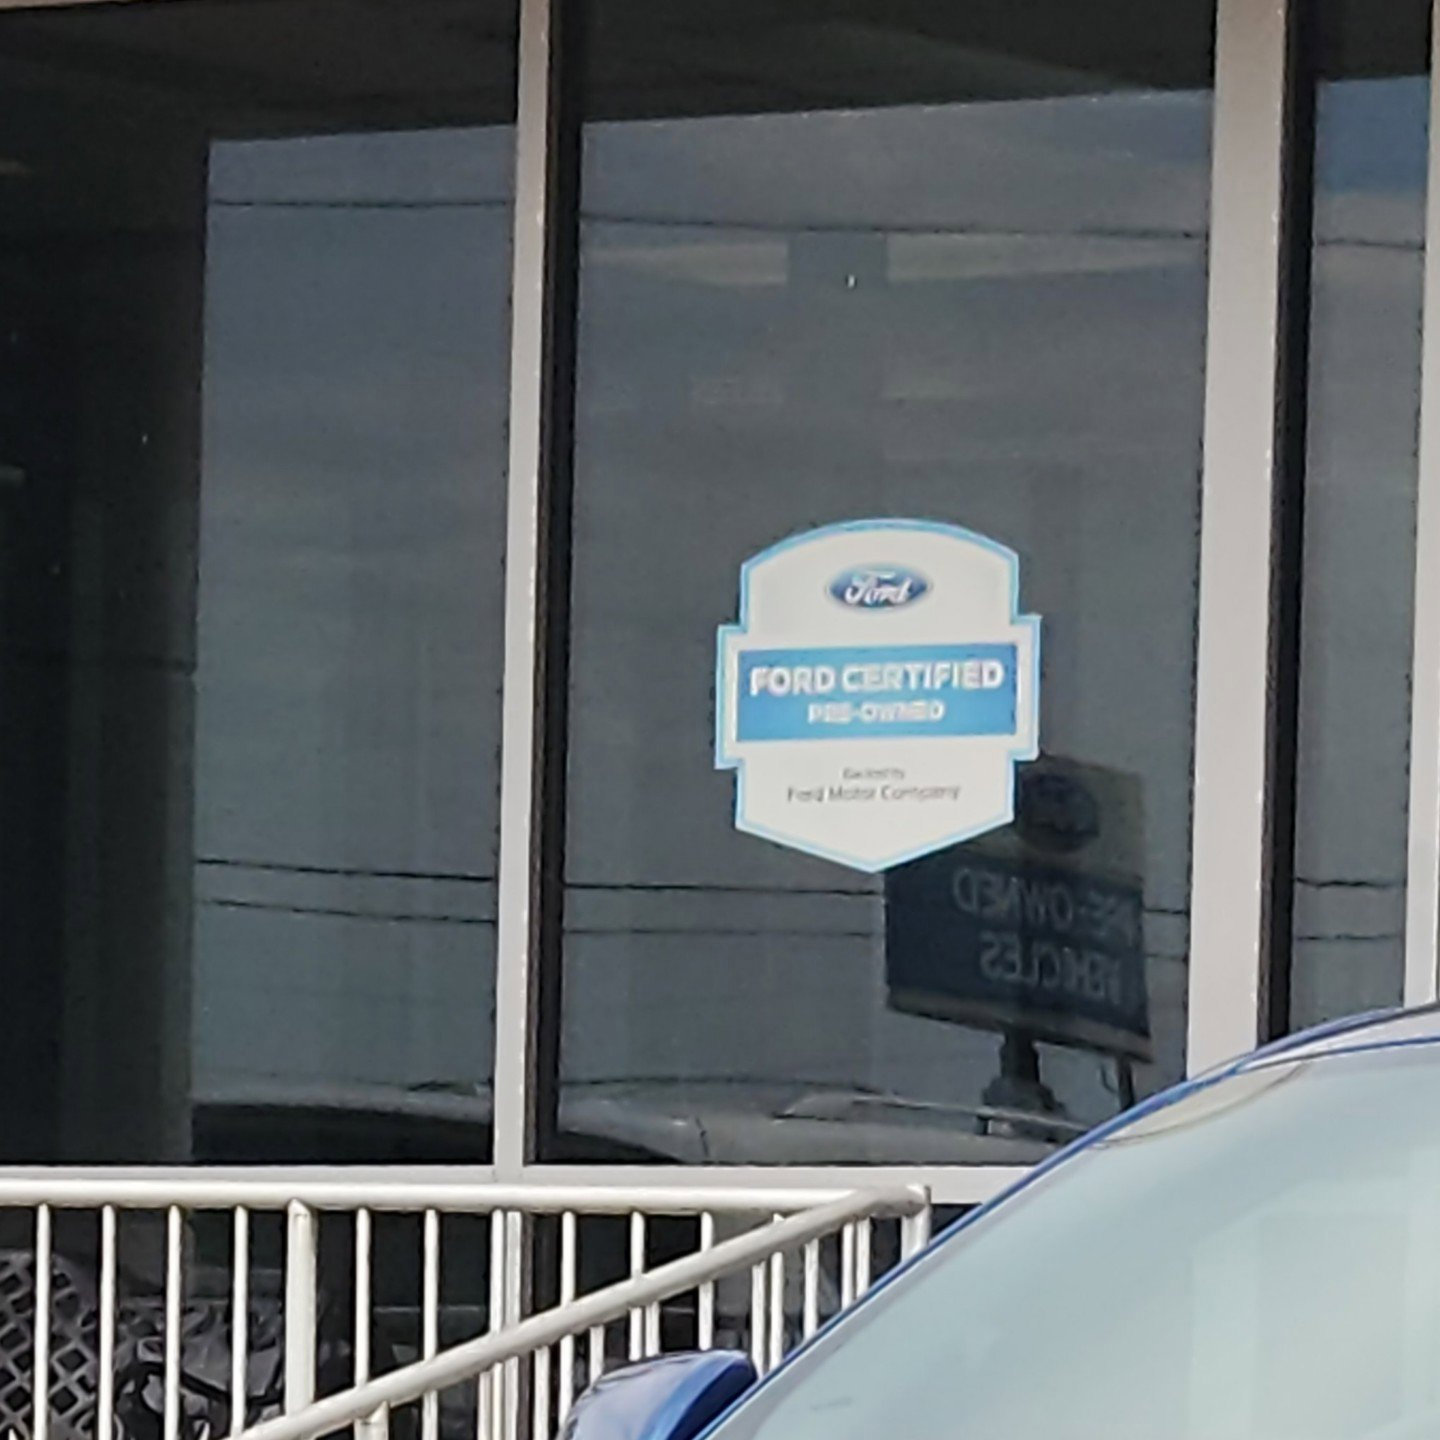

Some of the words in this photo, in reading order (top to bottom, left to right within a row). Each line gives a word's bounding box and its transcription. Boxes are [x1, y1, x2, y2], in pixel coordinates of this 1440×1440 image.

[845, 570, 913, 605] Ford
[750, 666, 835, 696] FORD
[842, 659, 1005, 693] CERTIFIED
[807, 699, 946, 724] PRE-OWNED
